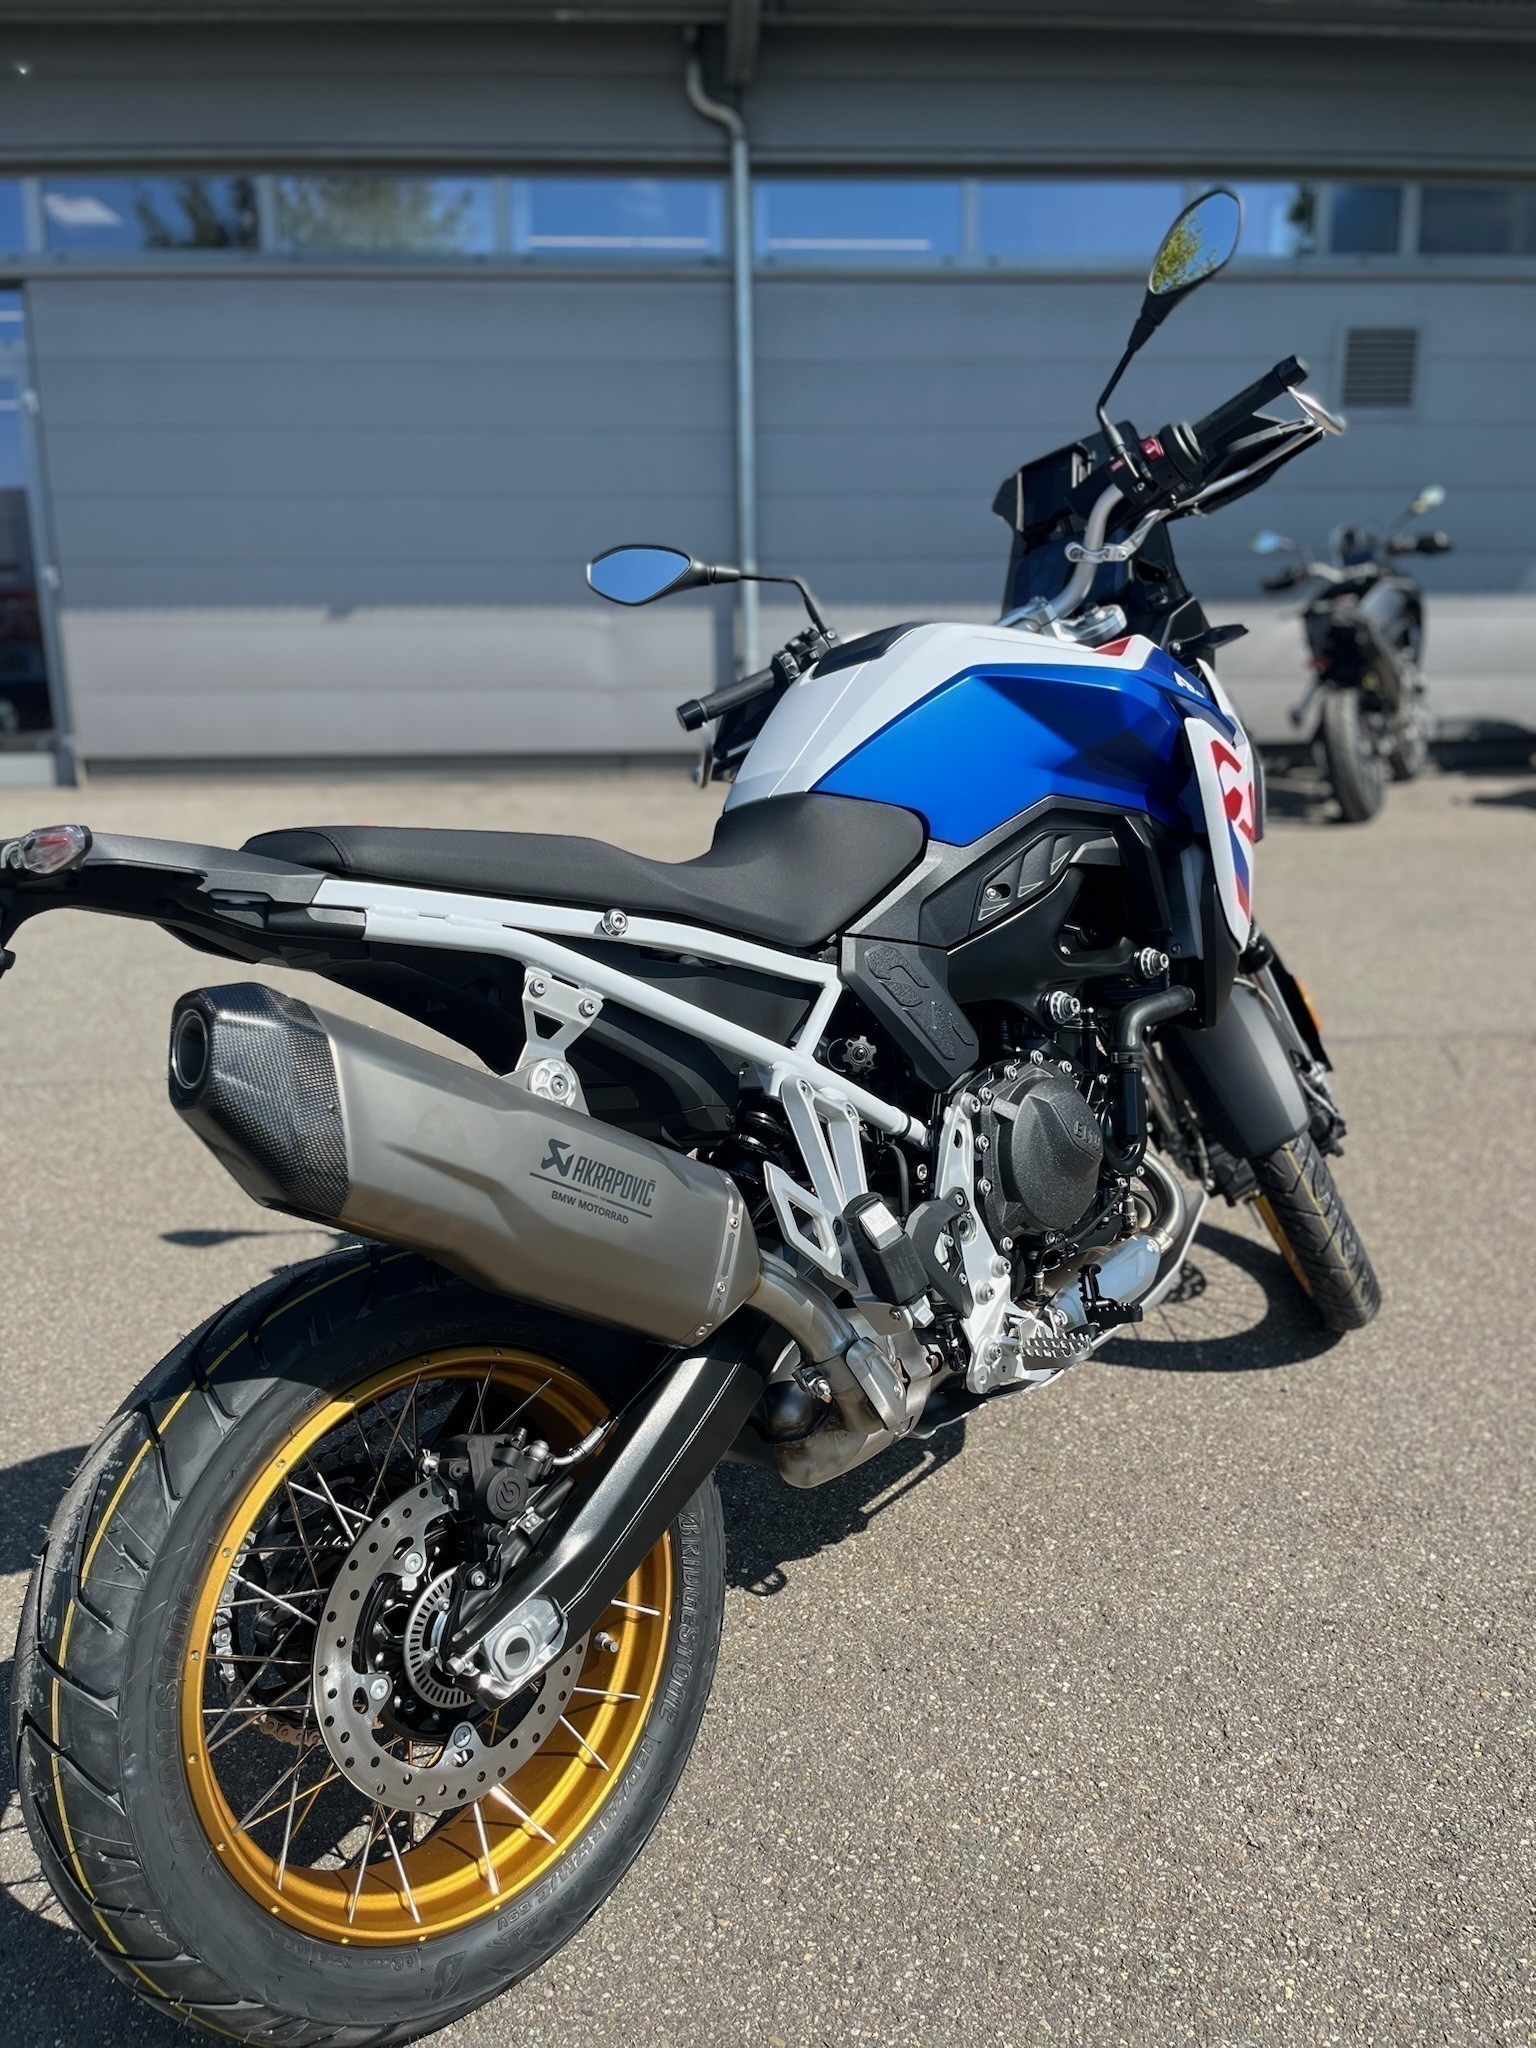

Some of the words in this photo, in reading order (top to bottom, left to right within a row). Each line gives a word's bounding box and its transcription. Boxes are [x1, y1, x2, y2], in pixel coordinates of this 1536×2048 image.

[551, 1190, 577, 1206] BMW
[577, 1199, 629, 1225] MOTORRAD
[572, 1155, 656, 1208] AKRAPOVIČ
[658, 1511, 702, 1728] BRIDGESTONE
